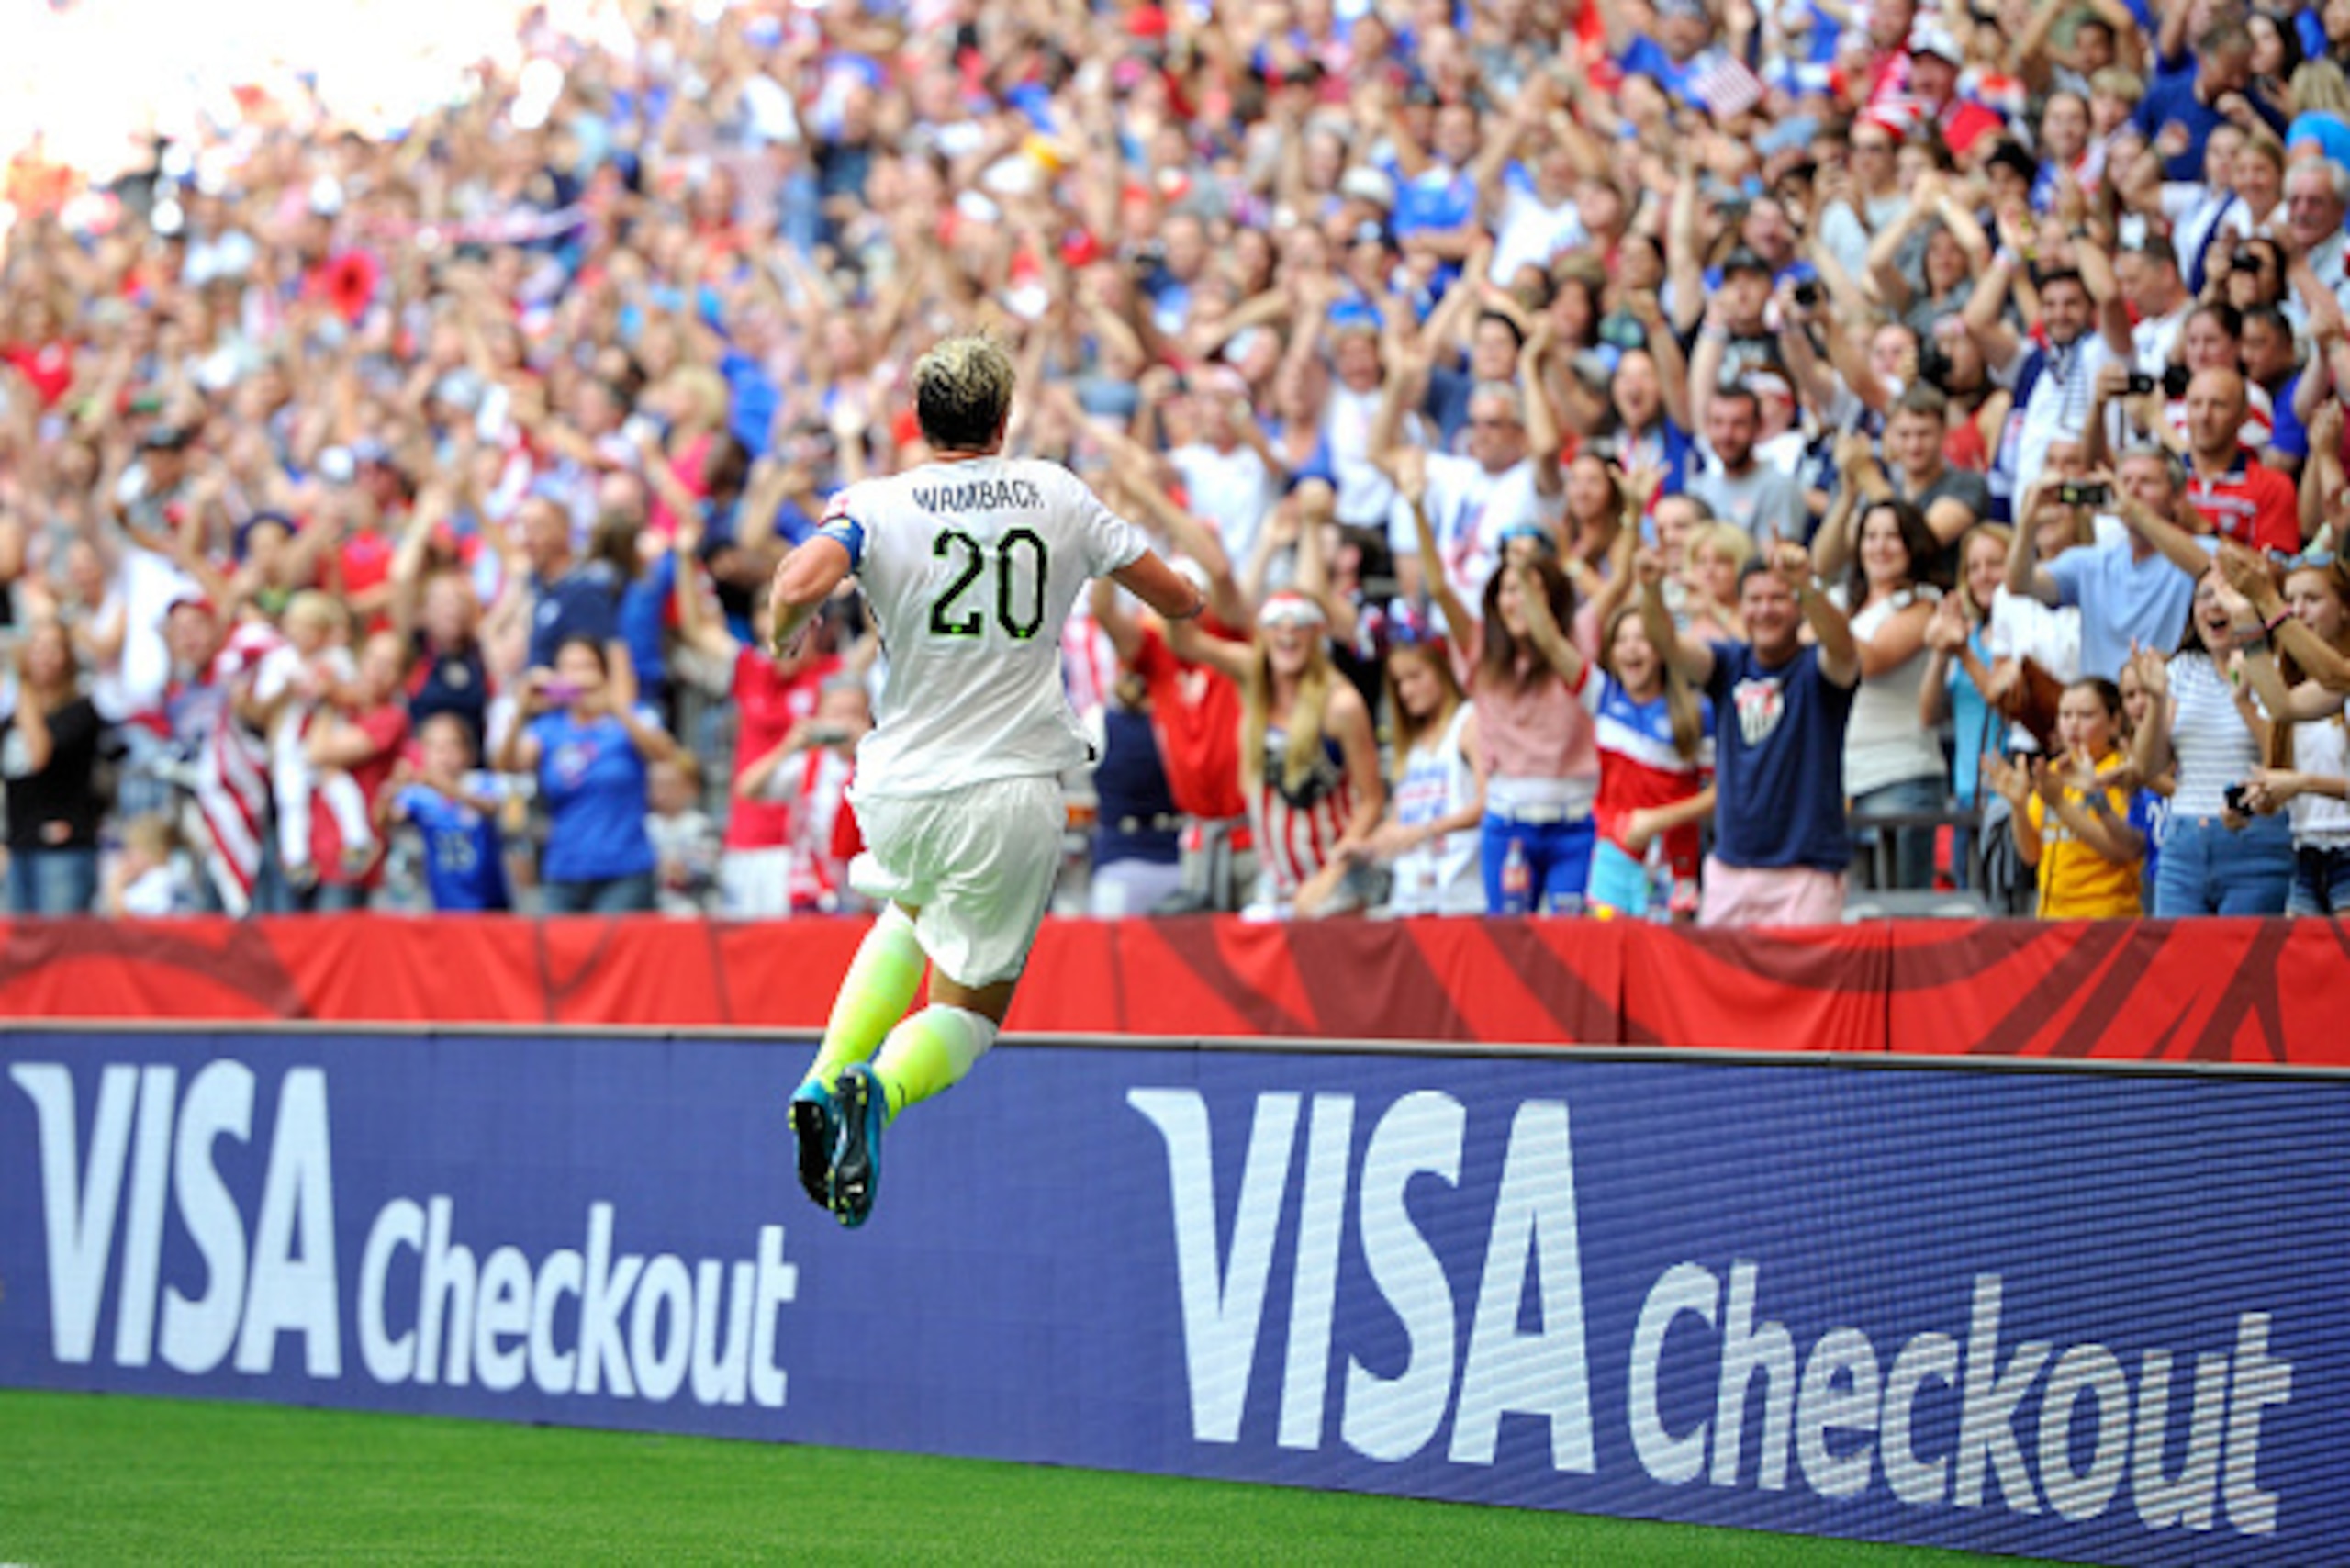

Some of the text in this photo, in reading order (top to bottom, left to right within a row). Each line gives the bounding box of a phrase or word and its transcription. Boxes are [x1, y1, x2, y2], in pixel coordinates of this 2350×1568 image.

[931, 528, 1048, 639] 20
[10, 1059, 798, 1407] VISA Checkout
[1126, 1087, 2294, 1536] VISA Checkout
